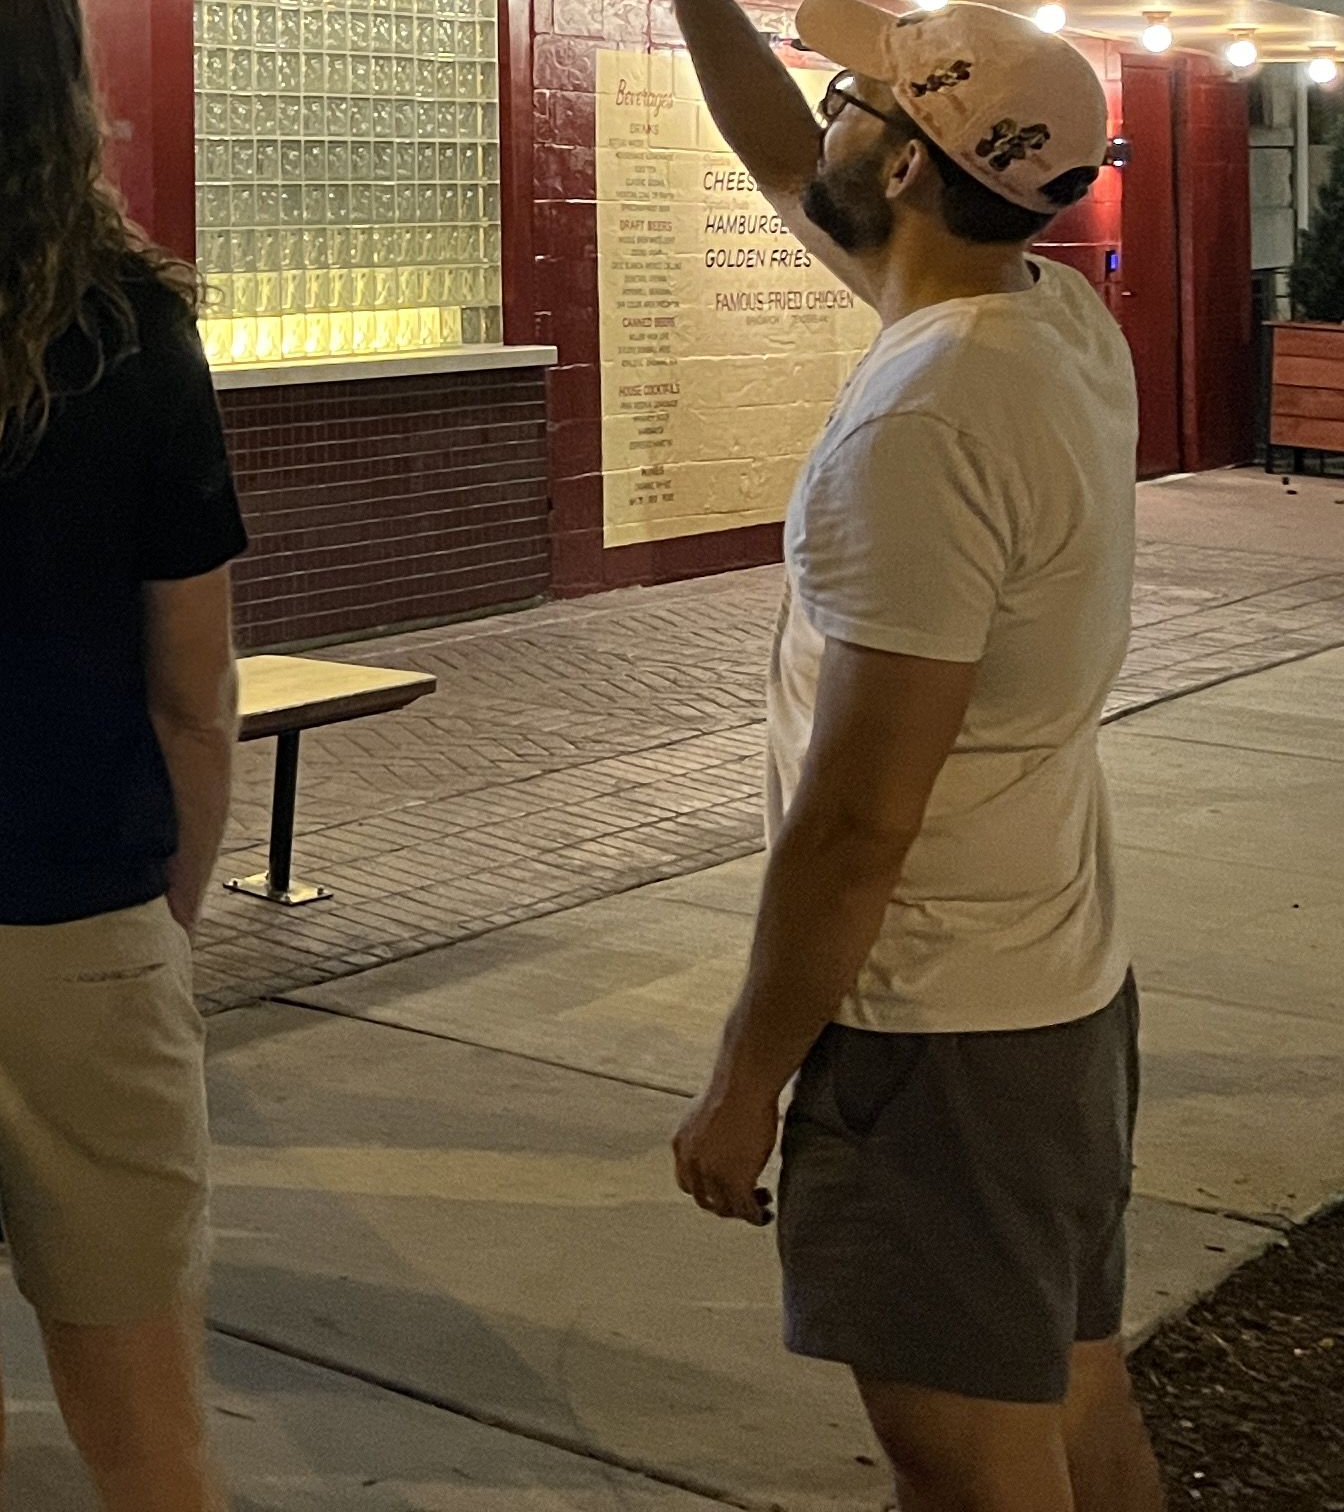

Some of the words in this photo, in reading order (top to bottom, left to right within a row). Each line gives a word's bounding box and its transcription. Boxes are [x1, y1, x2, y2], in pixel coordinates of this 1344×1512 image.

[615, 78, 674, 117] Beverages
[703, 171, 760, 191] CHEES
[705, 248, 764, 268] GOLDEN
[769, 248, 812, 268] FRIES
[715, 291, 763, 312] FAMOUS
[768, 291, 802, 310] FRIED
[806, 290, 854, 309] CHICKEN
